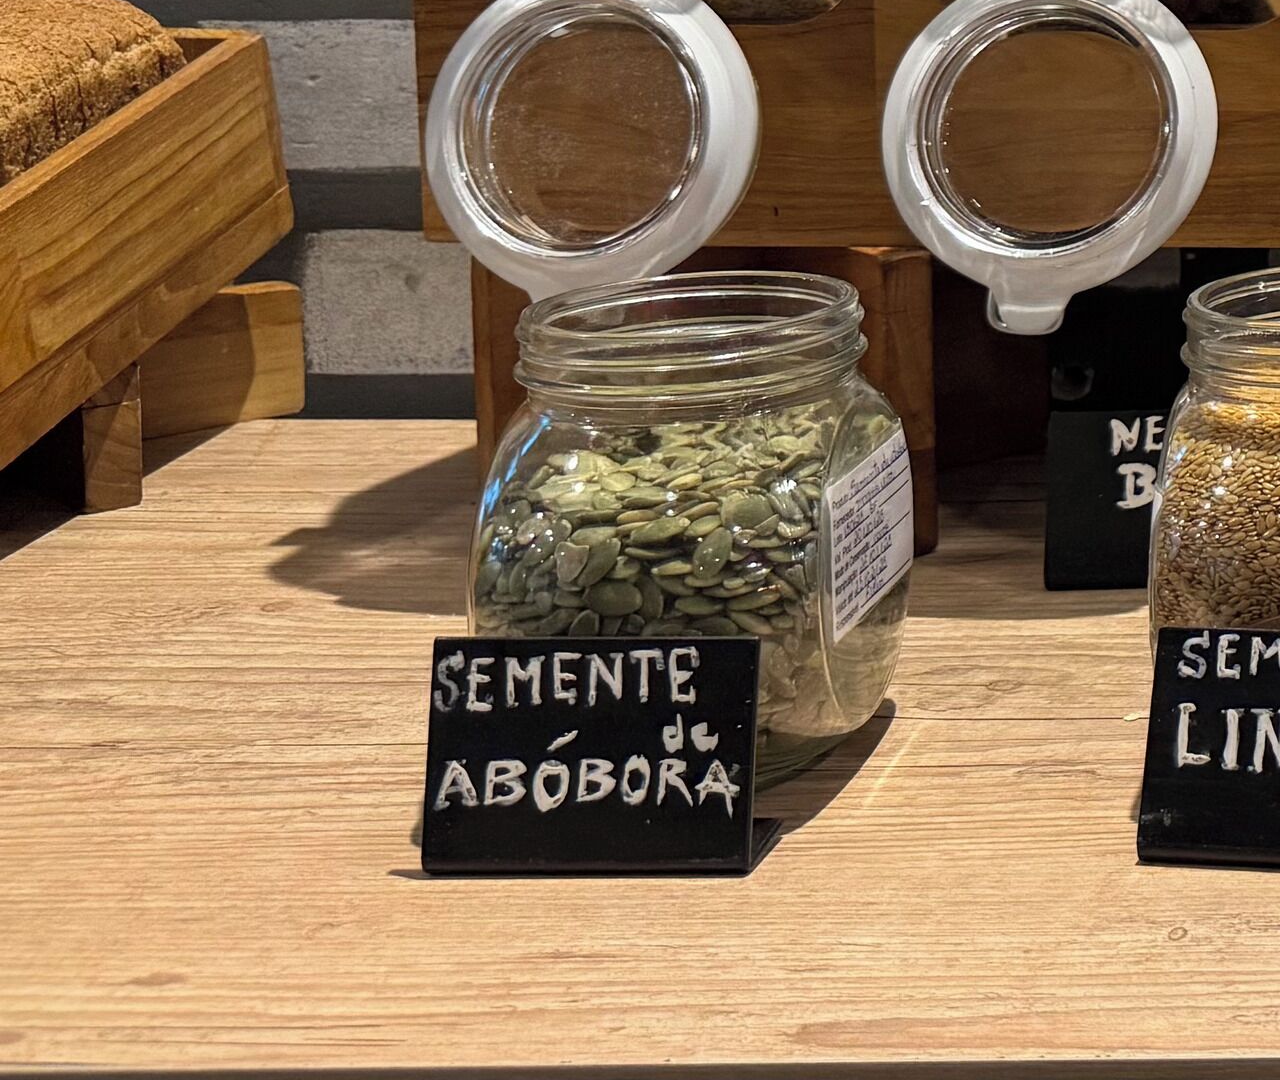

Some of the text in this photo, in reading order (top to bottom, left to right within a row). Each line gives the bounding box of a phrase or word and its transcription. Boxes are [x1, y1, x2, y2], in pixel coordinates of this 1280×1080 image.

[435, 646, 700, 712] SEMENTE
[662, 714, 720, 752] de
[434, 729, 741, 819] ABÓBORA
